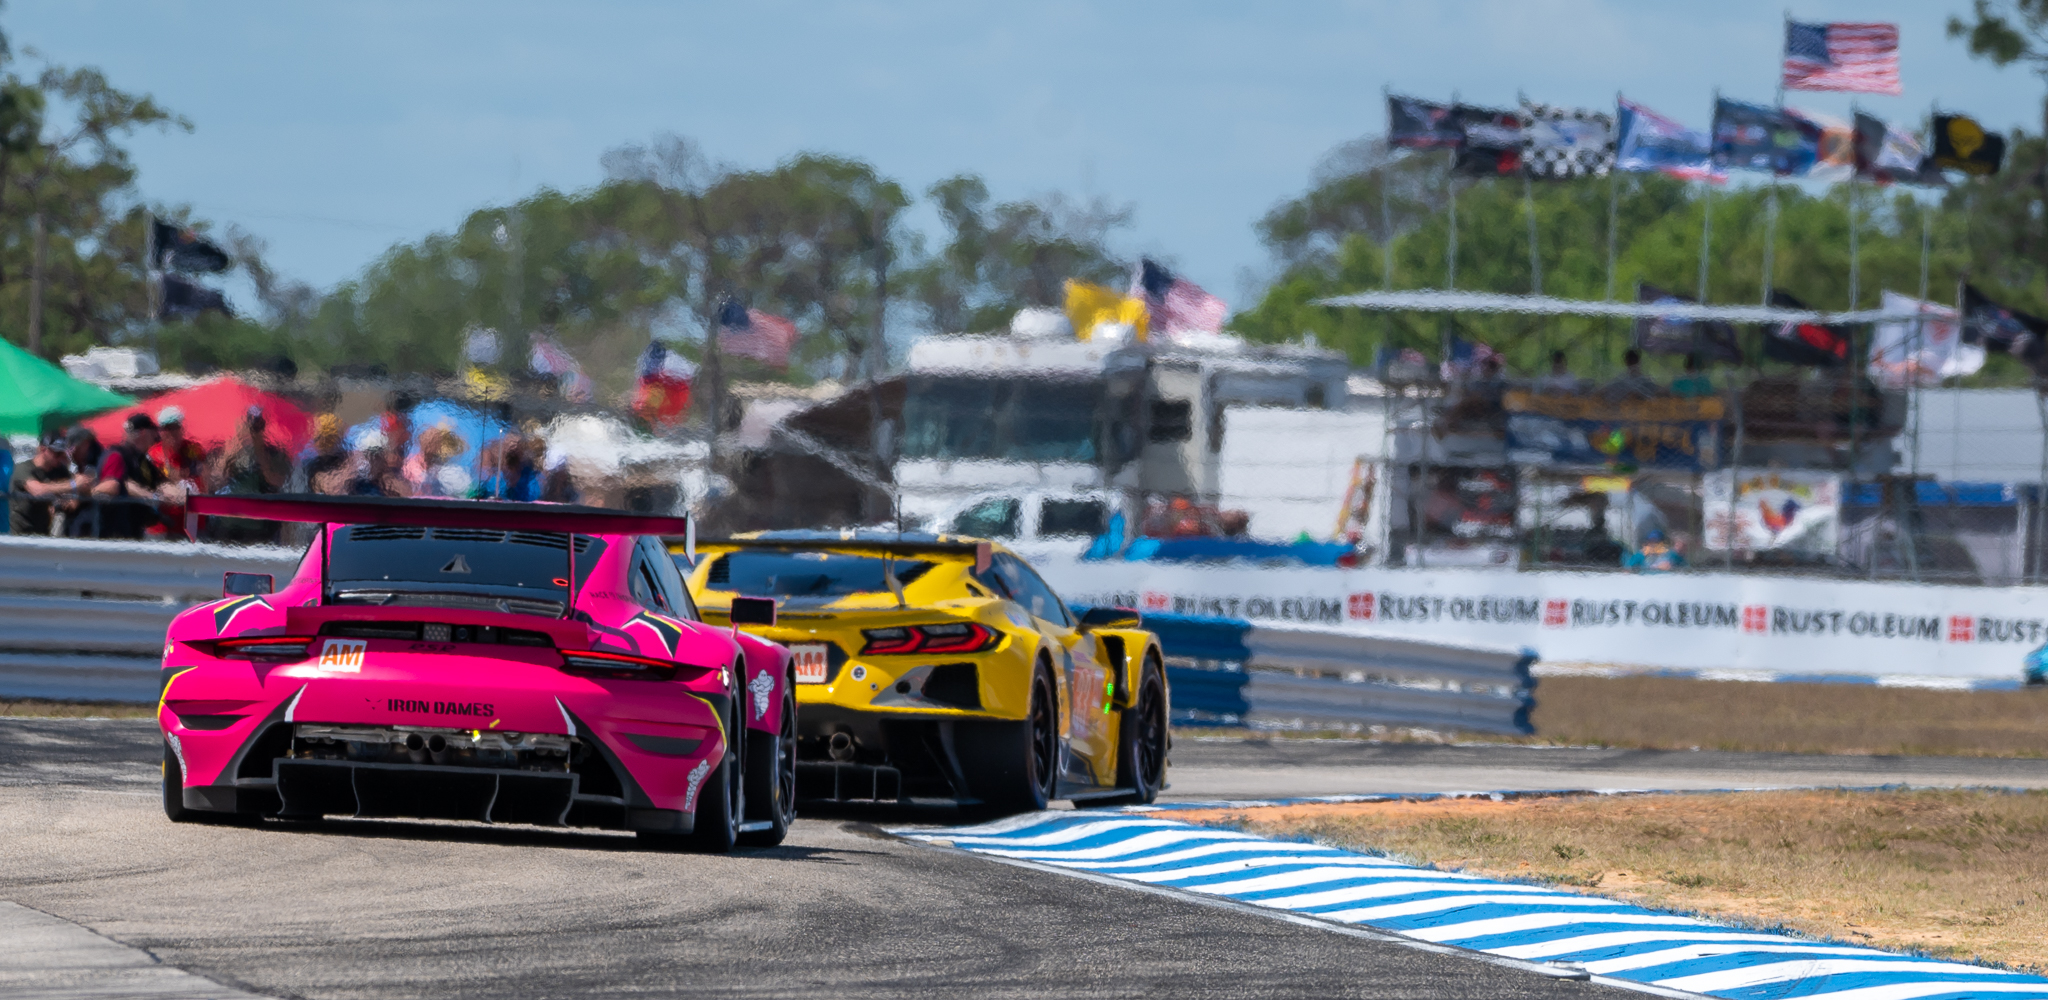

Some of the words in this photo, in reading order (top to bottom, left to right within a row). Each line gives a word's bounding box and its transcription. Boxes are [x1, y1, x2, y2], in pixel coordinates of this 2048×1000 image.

[321, 643, 364, 666] AM
[794, 652, 823, 676] AM
[387, 698, 430, 714] IRON
[434, 701, 495, 718] DAMES
